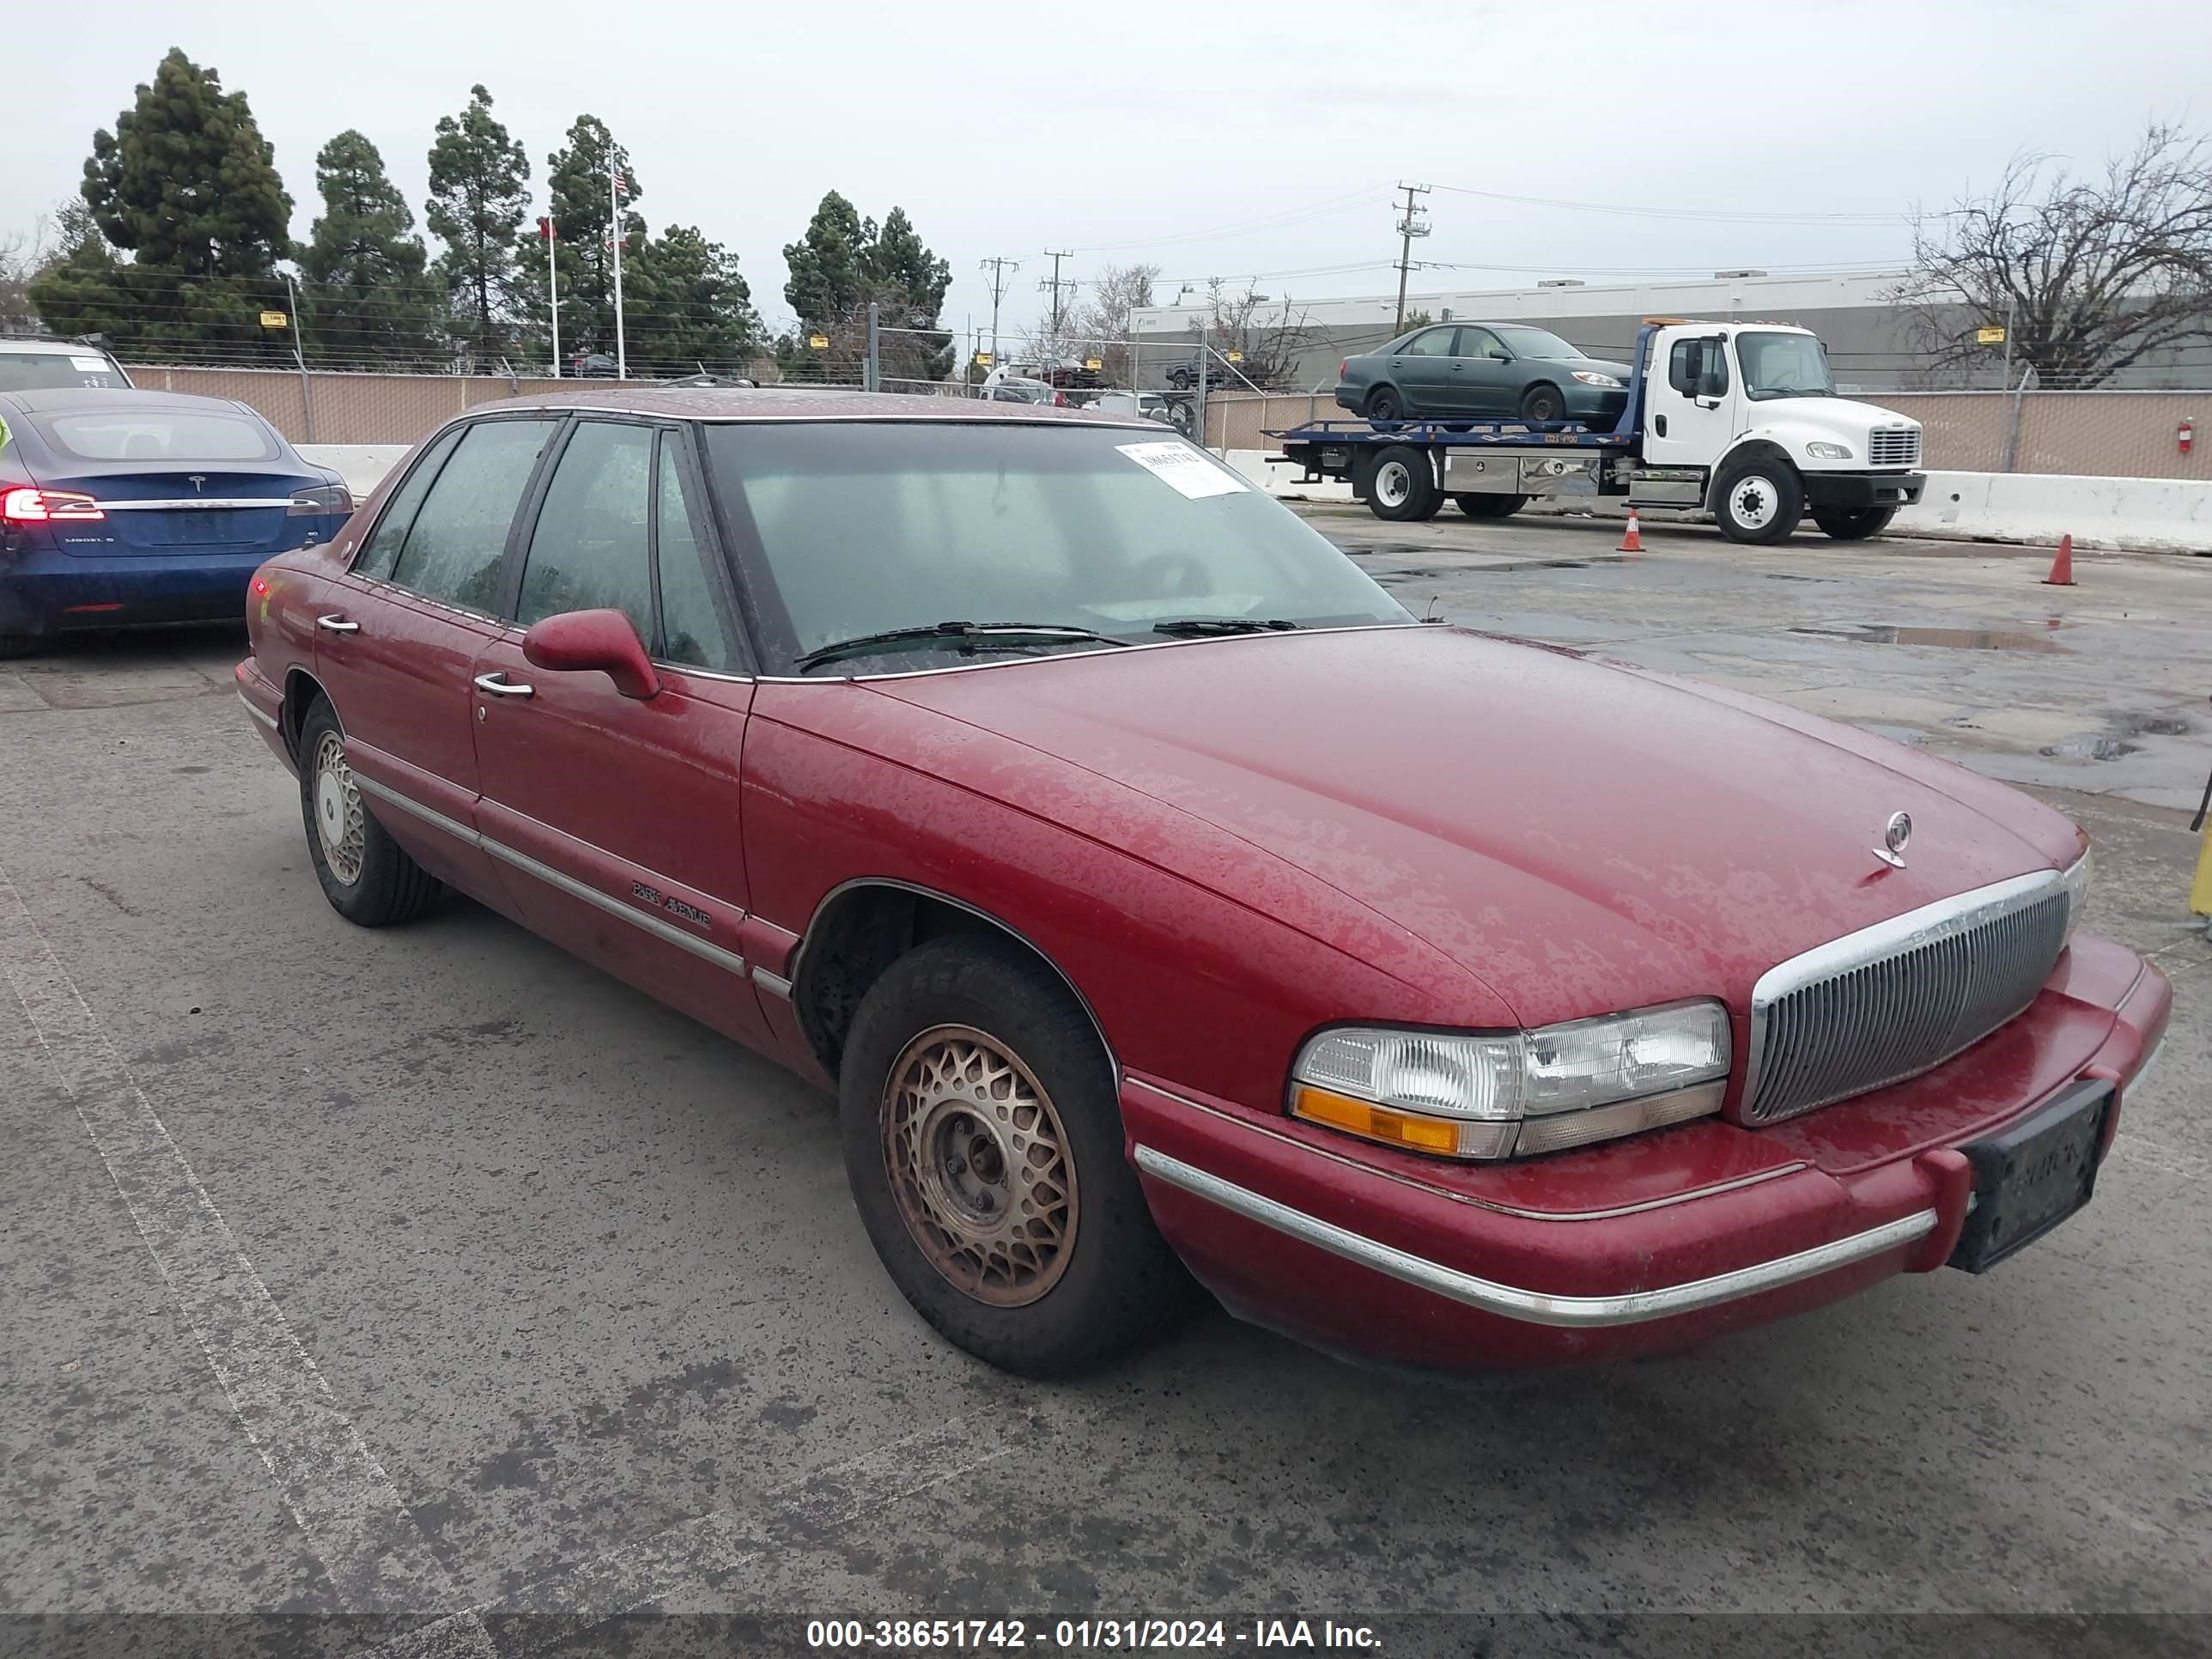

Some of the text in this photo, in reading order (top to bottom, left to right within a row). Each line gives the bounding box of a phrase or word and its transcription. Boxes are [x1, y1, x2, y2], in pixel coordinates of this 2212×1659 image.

[1141, 453, 1200, 466] 38651742
[633, 882, 712, 927] PARK AVENUE
